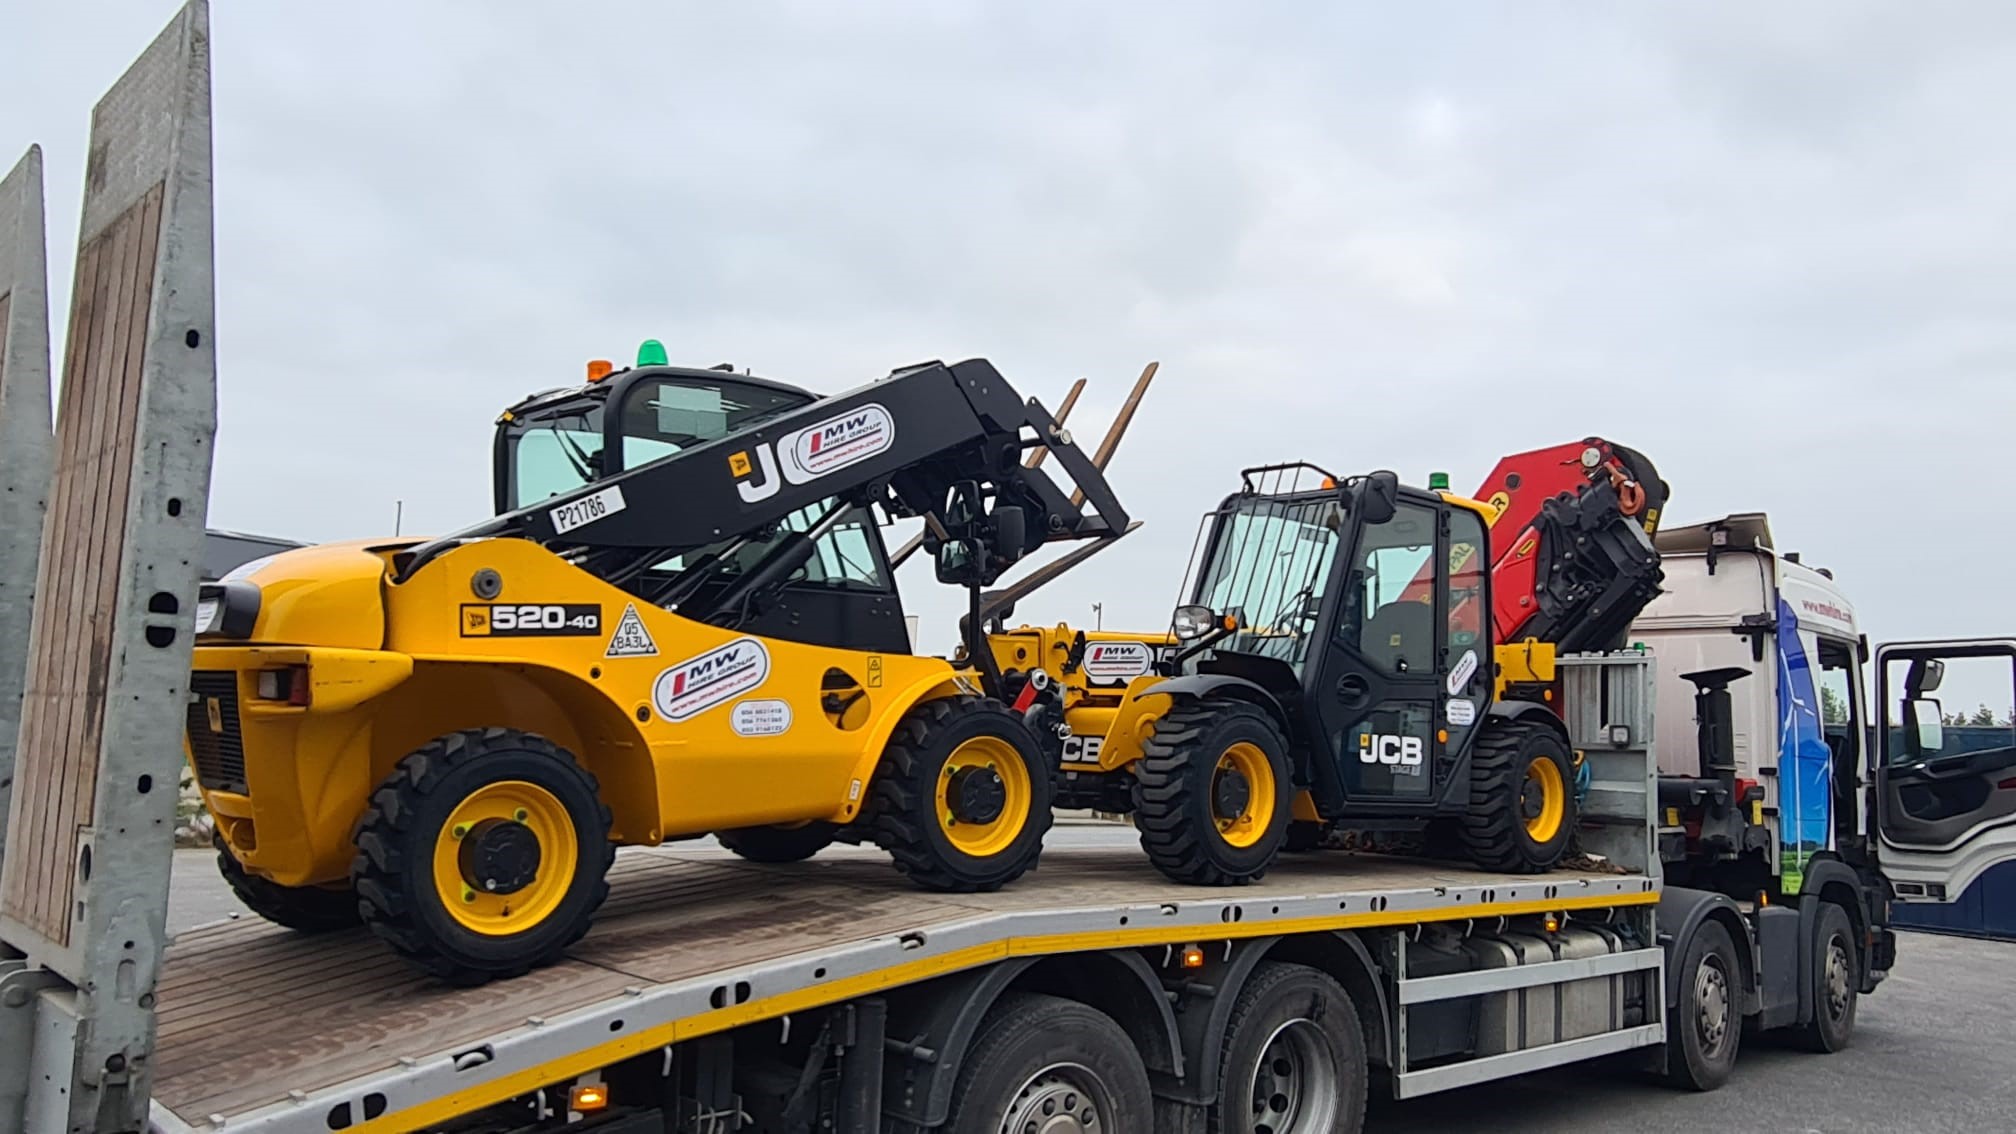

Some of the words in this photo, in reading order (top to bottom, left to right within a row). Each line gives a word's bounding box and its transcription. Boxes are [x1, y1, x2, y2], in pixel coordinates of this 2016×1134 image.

[823, 436, 846, 448] HIRE
[849, 421, 881, 438] GROUP
[825, 414, 867, 439] MW
[557, 495, 606, 529] P21786
[491, 605, 598, 630] 520-40
[689, 648, 740, 679] MW
[1104, 647, 1136, 655] MW
[688, 673, 715, 689] HIRE
[717, 655, 757, 676] GROUP
[1061, 736, 1105, 762] CB
[1360, 734, 1422, 765] JCB
